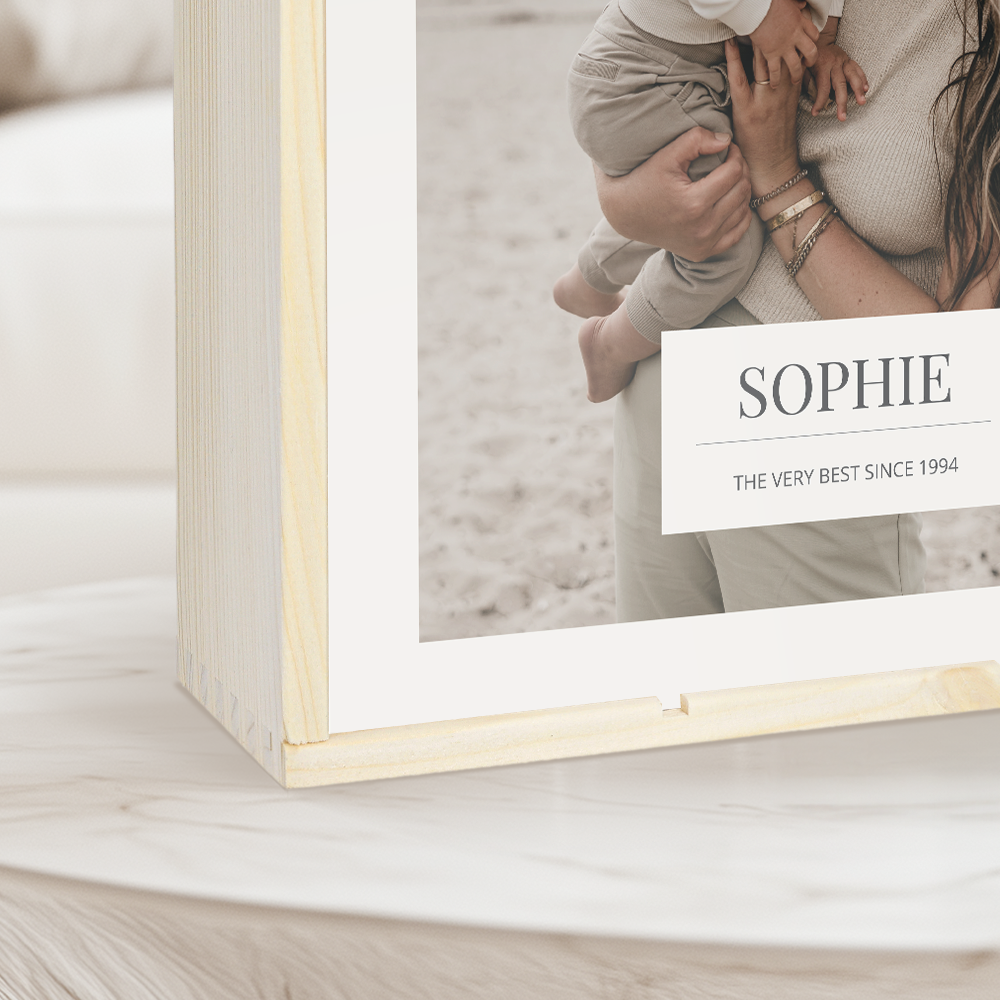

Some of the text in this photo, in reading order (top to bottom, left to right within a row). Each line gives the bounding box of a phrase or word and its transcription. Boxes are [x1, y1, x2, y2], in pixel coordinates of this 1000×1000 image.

[739, 353, 951, 419] SOPHIE
[733, 457, 959, 491] THE VERY BEST SINCE 1994
